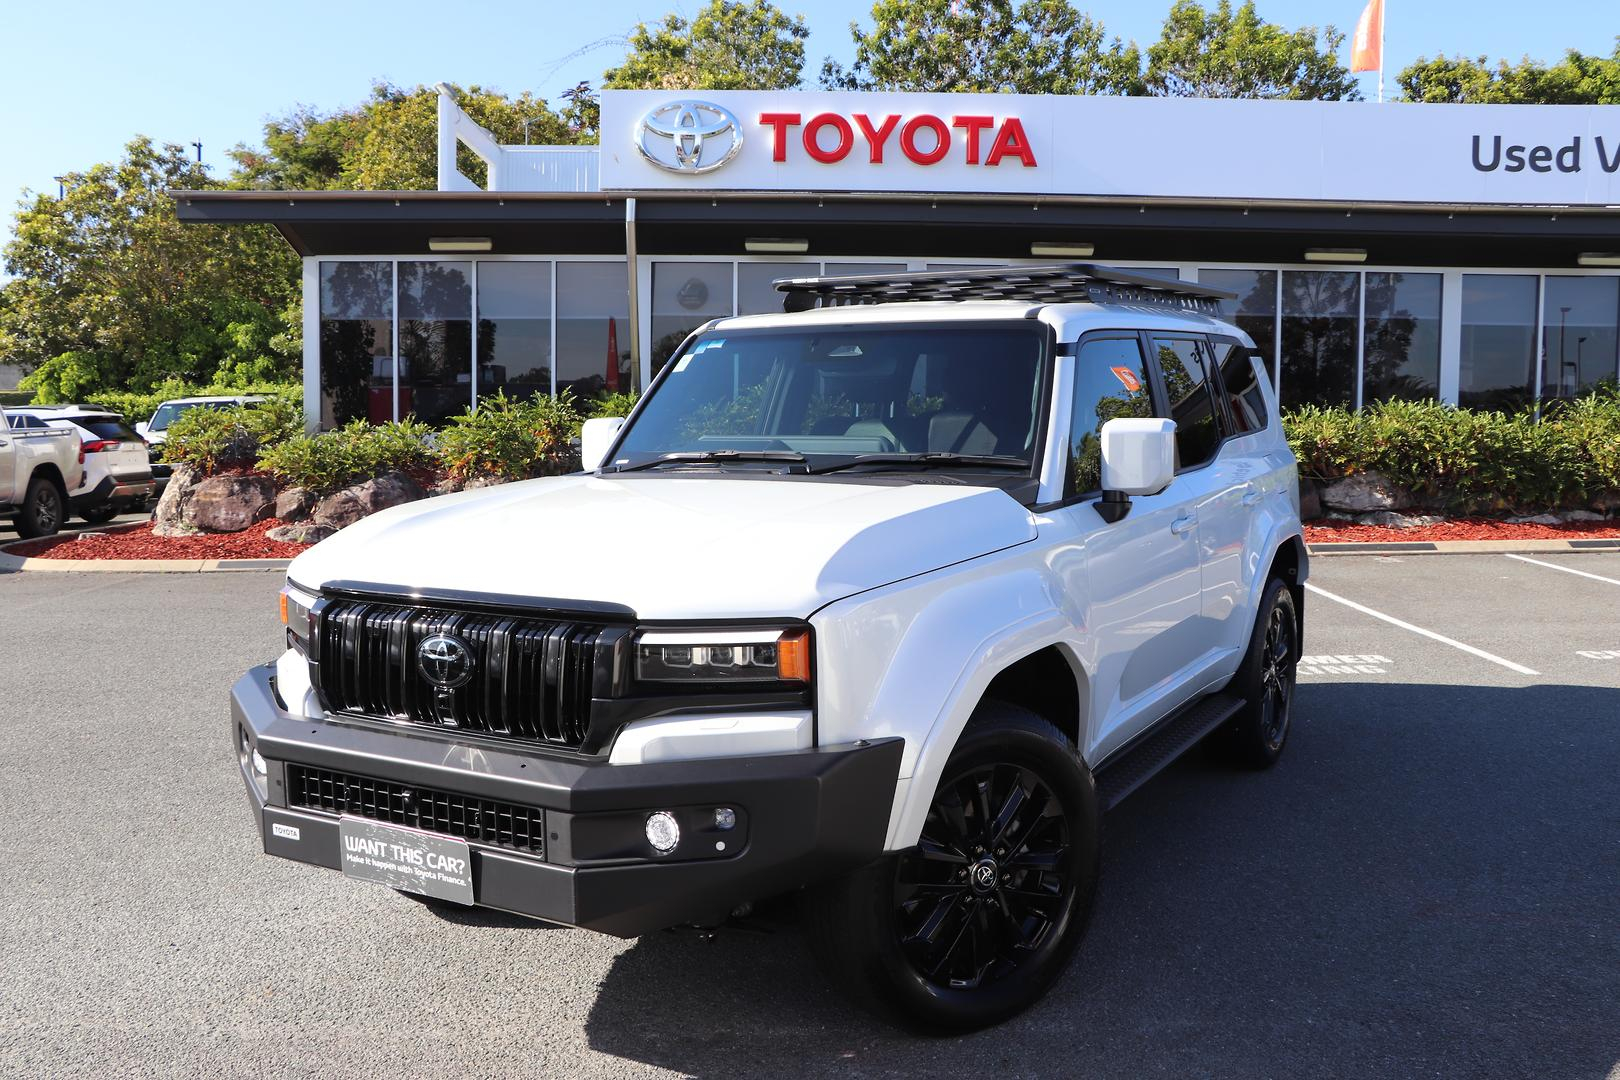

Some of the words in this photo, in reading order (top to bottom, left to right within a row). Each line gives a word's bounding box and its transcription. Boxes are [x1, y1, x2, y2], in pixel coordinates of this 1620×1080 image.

[759, 112, 1037, 167] TOYOTA
[1472, 135, 1581, 173] Used
[274, 826, 298, 837] TOYOTA
[344, 835, 387, 857] WANT
[390, 844, 423, 865] THIS
[426, 852, 465, 874] CAR?
[346, 853, 365, 864] Make
[365, 856, 371, 866] it
[371, 858, 397, 871] happen
[397, 865, 413, 874] with
[413, 867, 437, 881] Toyota
[437, 872, 467, 887] Finance.
